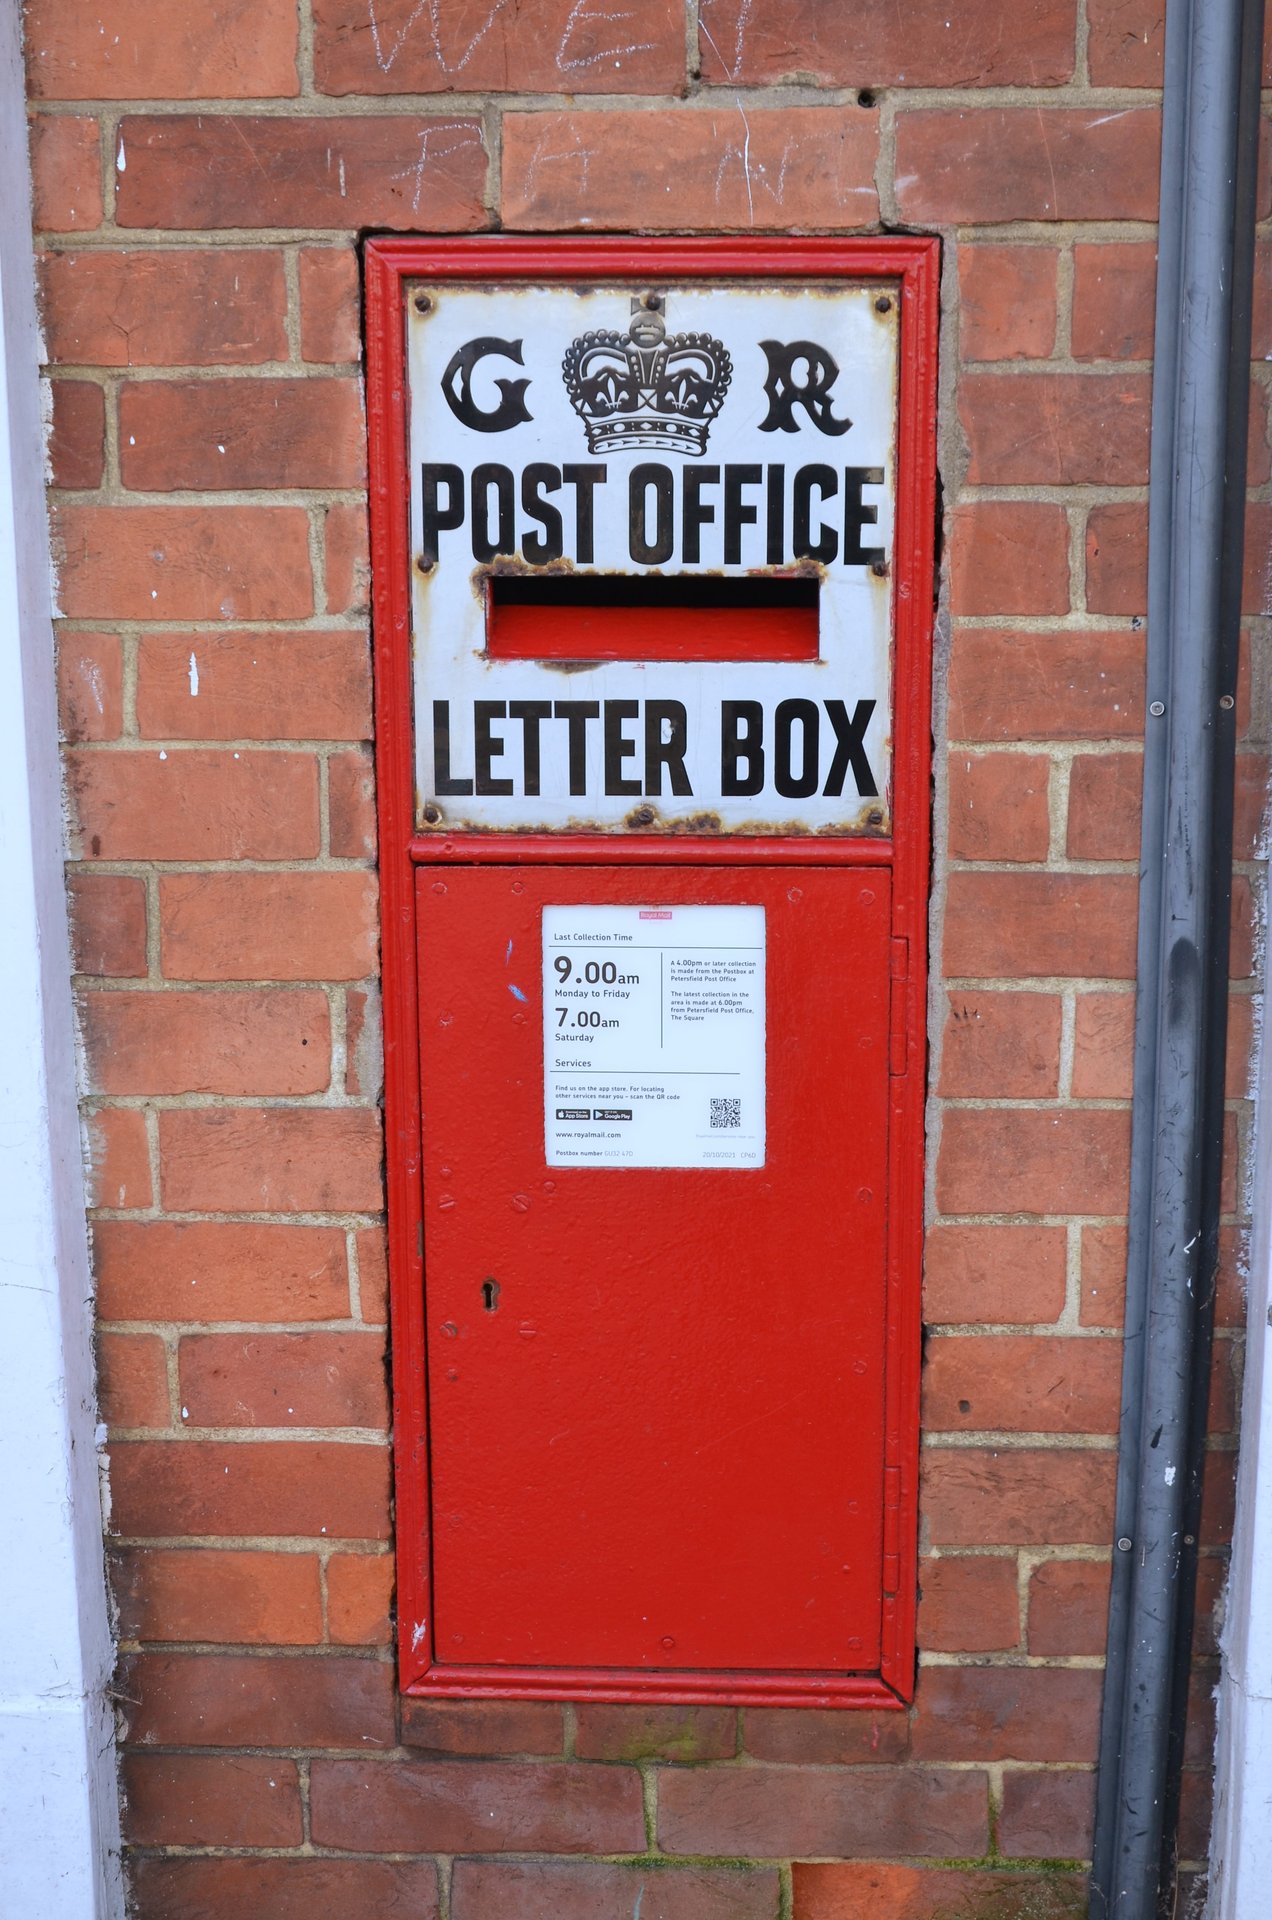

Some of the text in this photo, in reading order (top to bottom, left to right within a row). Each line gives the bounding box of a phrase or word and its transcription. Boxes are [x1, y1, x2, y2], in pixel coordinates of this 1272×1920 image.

[440, 336, 854, 437] G R
[421, 462, 885, 566] POST OFFICE
[433, 698, 879, 799] LETTER BOX
[554, 933, 571, 941] Last
[573, 933, 611, 941] Collection
[554, 956, 639, 984] 9.00am
[555, 989, 588, 998] Monday
[603, 990, 630, 999] Friday
[555, 1008, 620, 1028] 7.00am
[555, 1033, 594, 1043] Saturday
[556, 1059, 592, 1067] Services
